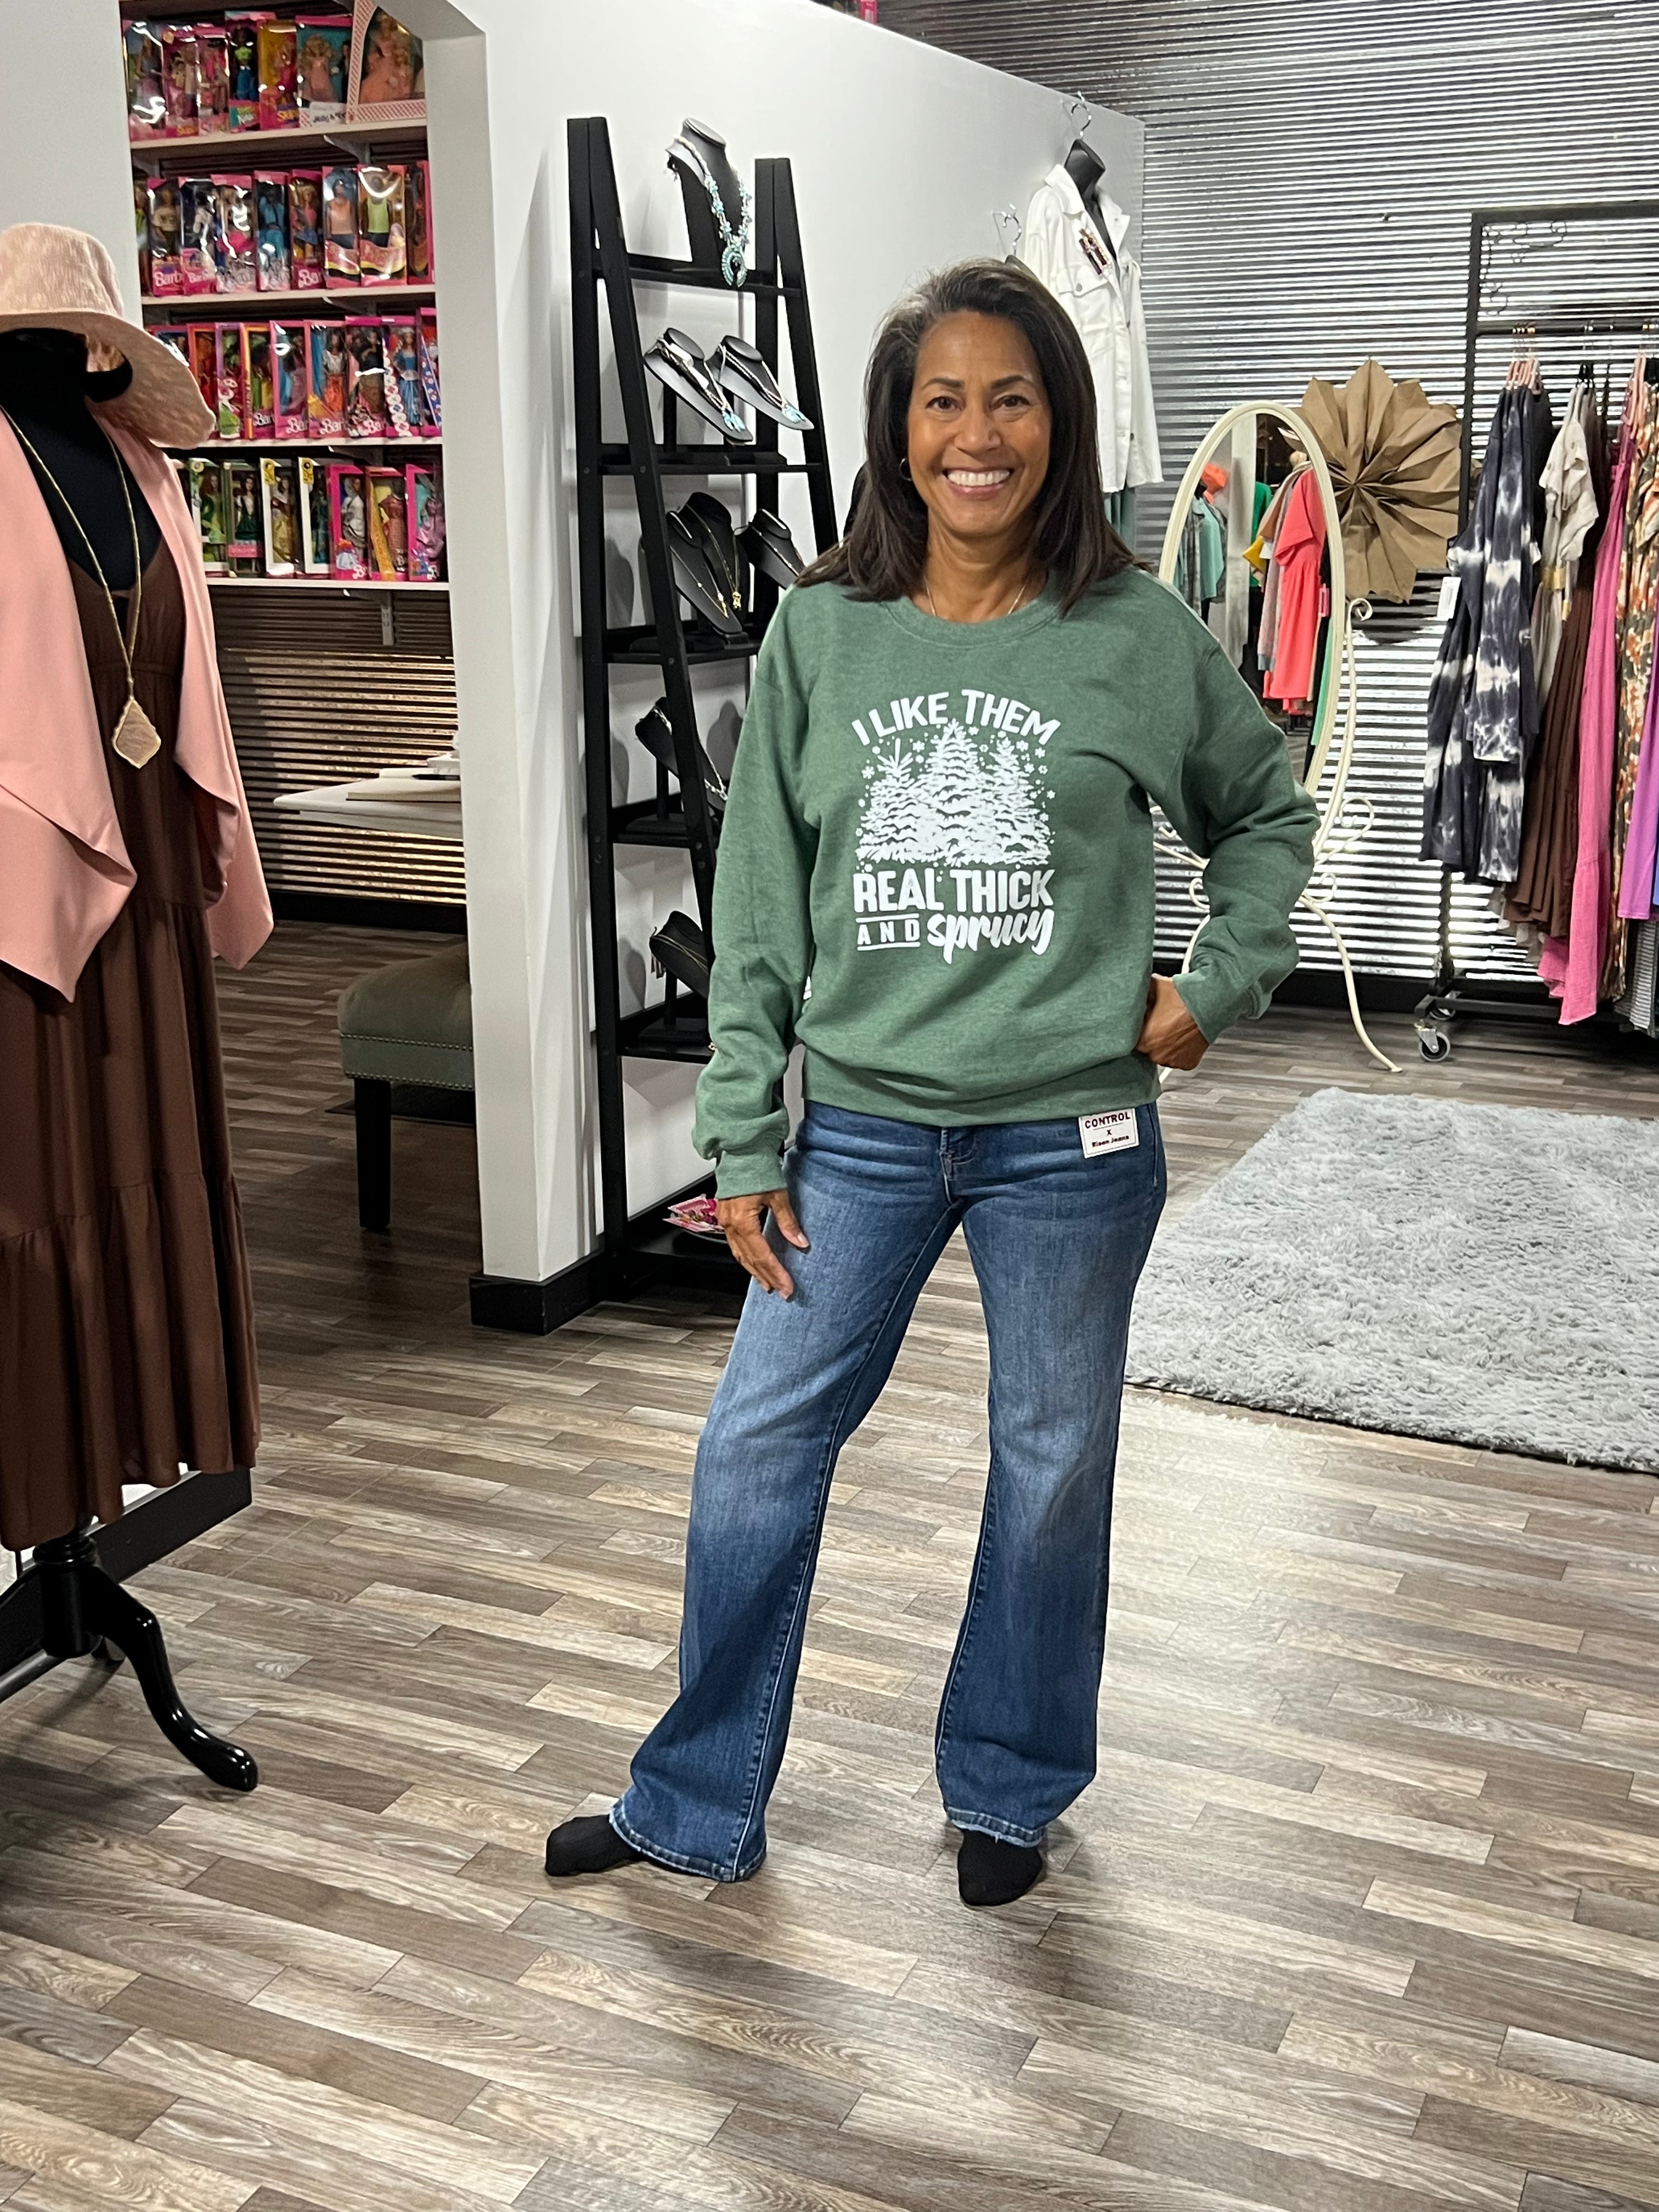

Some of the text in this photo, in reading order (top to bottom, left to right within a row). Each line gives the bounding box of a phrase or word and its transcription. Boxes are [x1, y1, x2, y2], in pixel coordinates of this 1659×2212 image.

[153, 270, 184, 287] Barb
[851, 689, 1061, 746] I LIKE THEM
[853, 868, 1056, 912] REAL THICK
[857, 909, 1054, 964] AND sprucy
[1085, 1111, 1130, 1128] CONTROL
